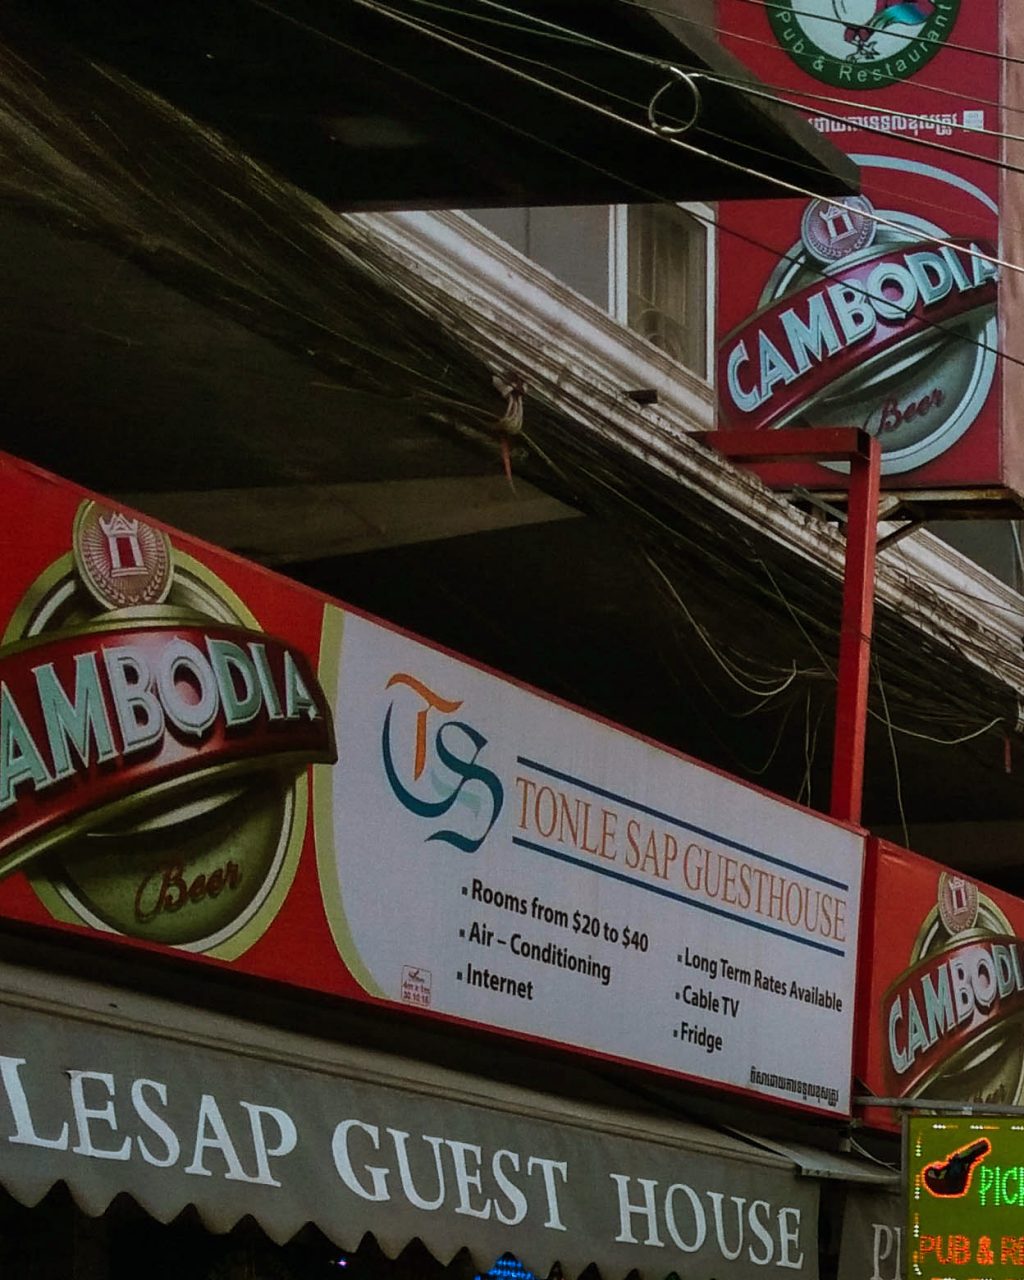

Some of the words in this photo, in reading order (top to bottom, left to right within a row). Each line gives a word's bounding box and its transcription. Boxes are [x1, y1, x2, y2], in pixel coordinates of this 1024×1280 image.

[776, 11, 804, 54] Pub
[813, 56, 825, 72] &
[839, 3, 952, 82] Restaurant
[727, 243, 999, 412] CAMBODIA
[863, 388, 945, 438] Beer
[0, 635, 322, 812] AMBODIA
[133, 858, 243, 924] Beer
[516, 777, 618, 862] TONLE
[625, 819, 678, 881] SAP
[684, 842, 846, 943] GUESTHOUSE
[472, 879, 527, 916] Rooms
[531, 897, 568, 930] from
[573, 909, 601, 940] $20
[604, 920, 619, 945] to
[622, 922, 649, 953] $40
[466, 963, 534, 1001] Internet
[469, 922, 494, 949] Air
[510, 934, 611, 986] Conditioning
[684, 948, 718, 982] Long
[720, 959, 751, 988] Term
[754, 968, 787, 998] Rates
[789, 977, 843, 1013] Available
[682, 985, 719, 1014] Cable
[720, 995, 740, 1018] TV
[681, 1022, 722, 1053] Fridge
[331, 1118, 567, 1231] GUEST
[610, 1174, 804, 1270] HOUSE
[919, 1234, 970, 1266] PUB
[976, 1235, 994, 1265] &
